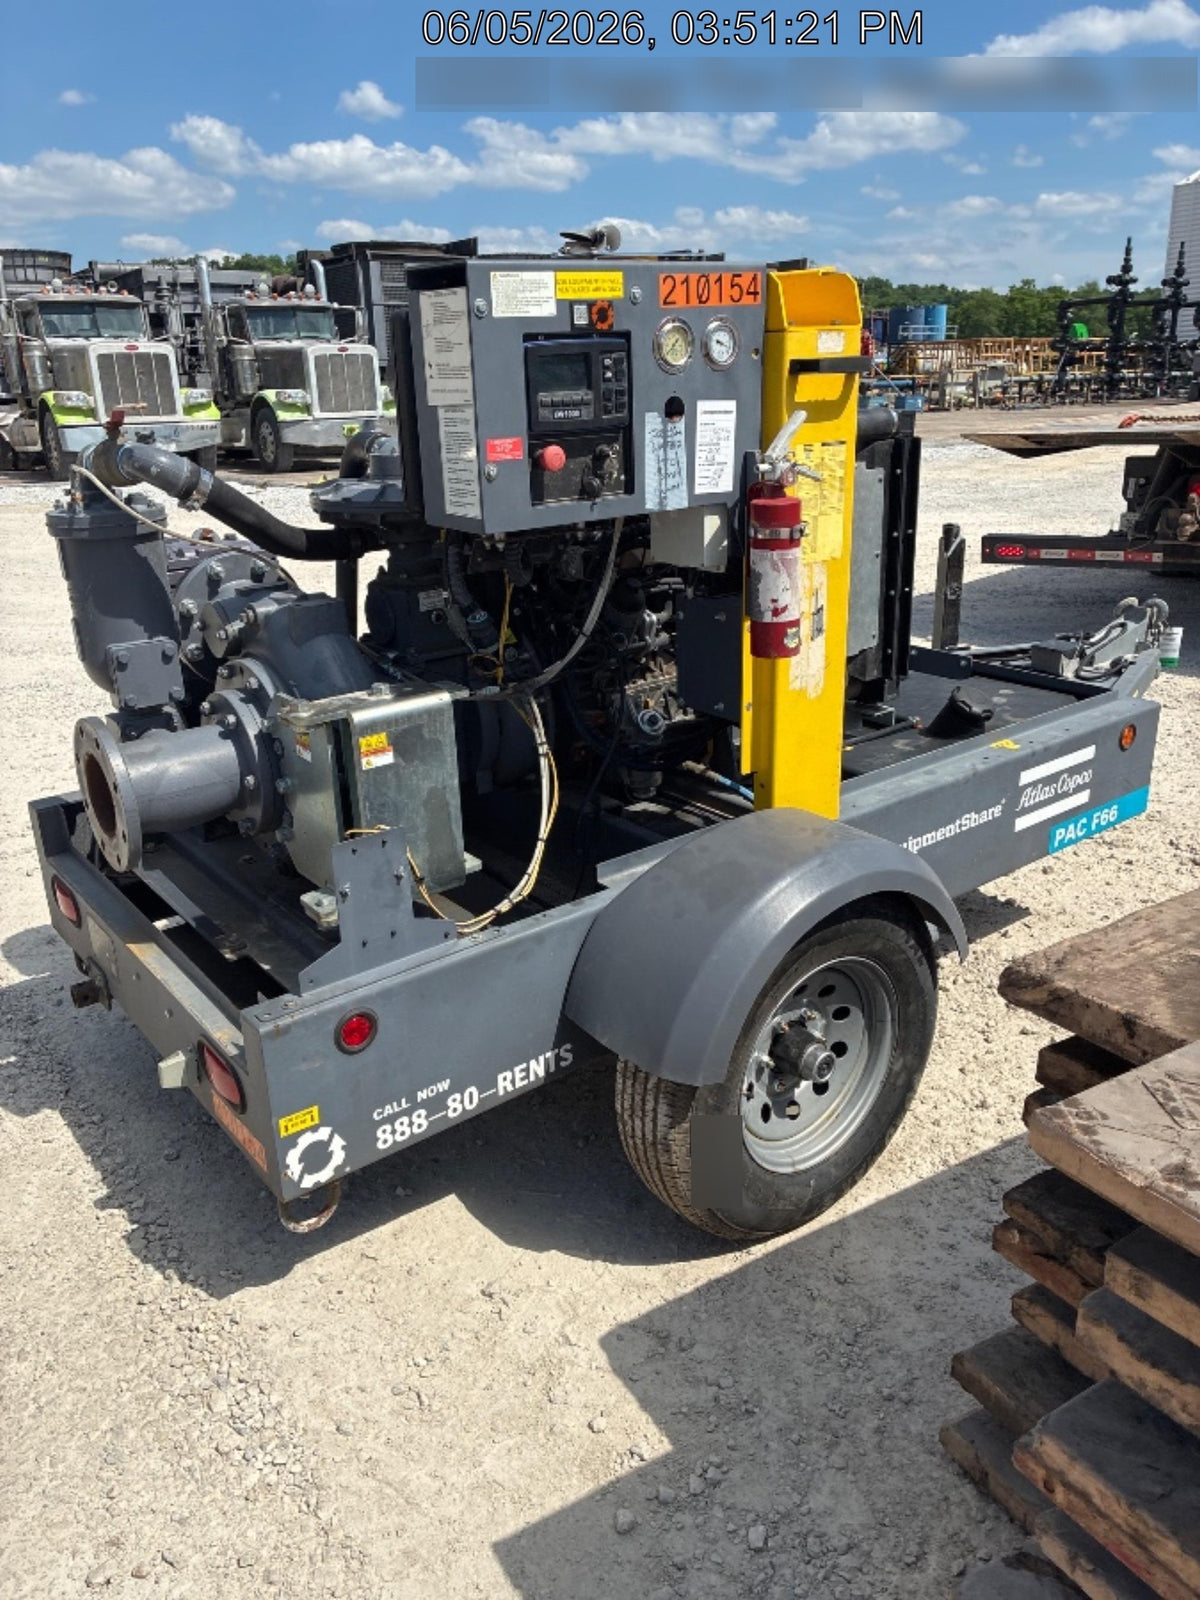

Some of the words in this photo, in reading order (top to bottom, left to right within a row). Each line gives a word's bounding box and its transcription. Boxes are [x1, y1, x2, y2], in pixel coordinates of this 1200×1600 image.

[662, 273, 760, 306] 210154
[1014, 781, 1057, 812] Atlas
[1057, 769, 1093, 794] Copco
[1053, 817, 1088, 848] PAC
[1091, 804, 1119, 832] F66
[373, 1097, 412, 1121] CALL
[417, 1078, 451, 1103] NOW
[376, 1043, 574, 1150] 888-80-RENTS
